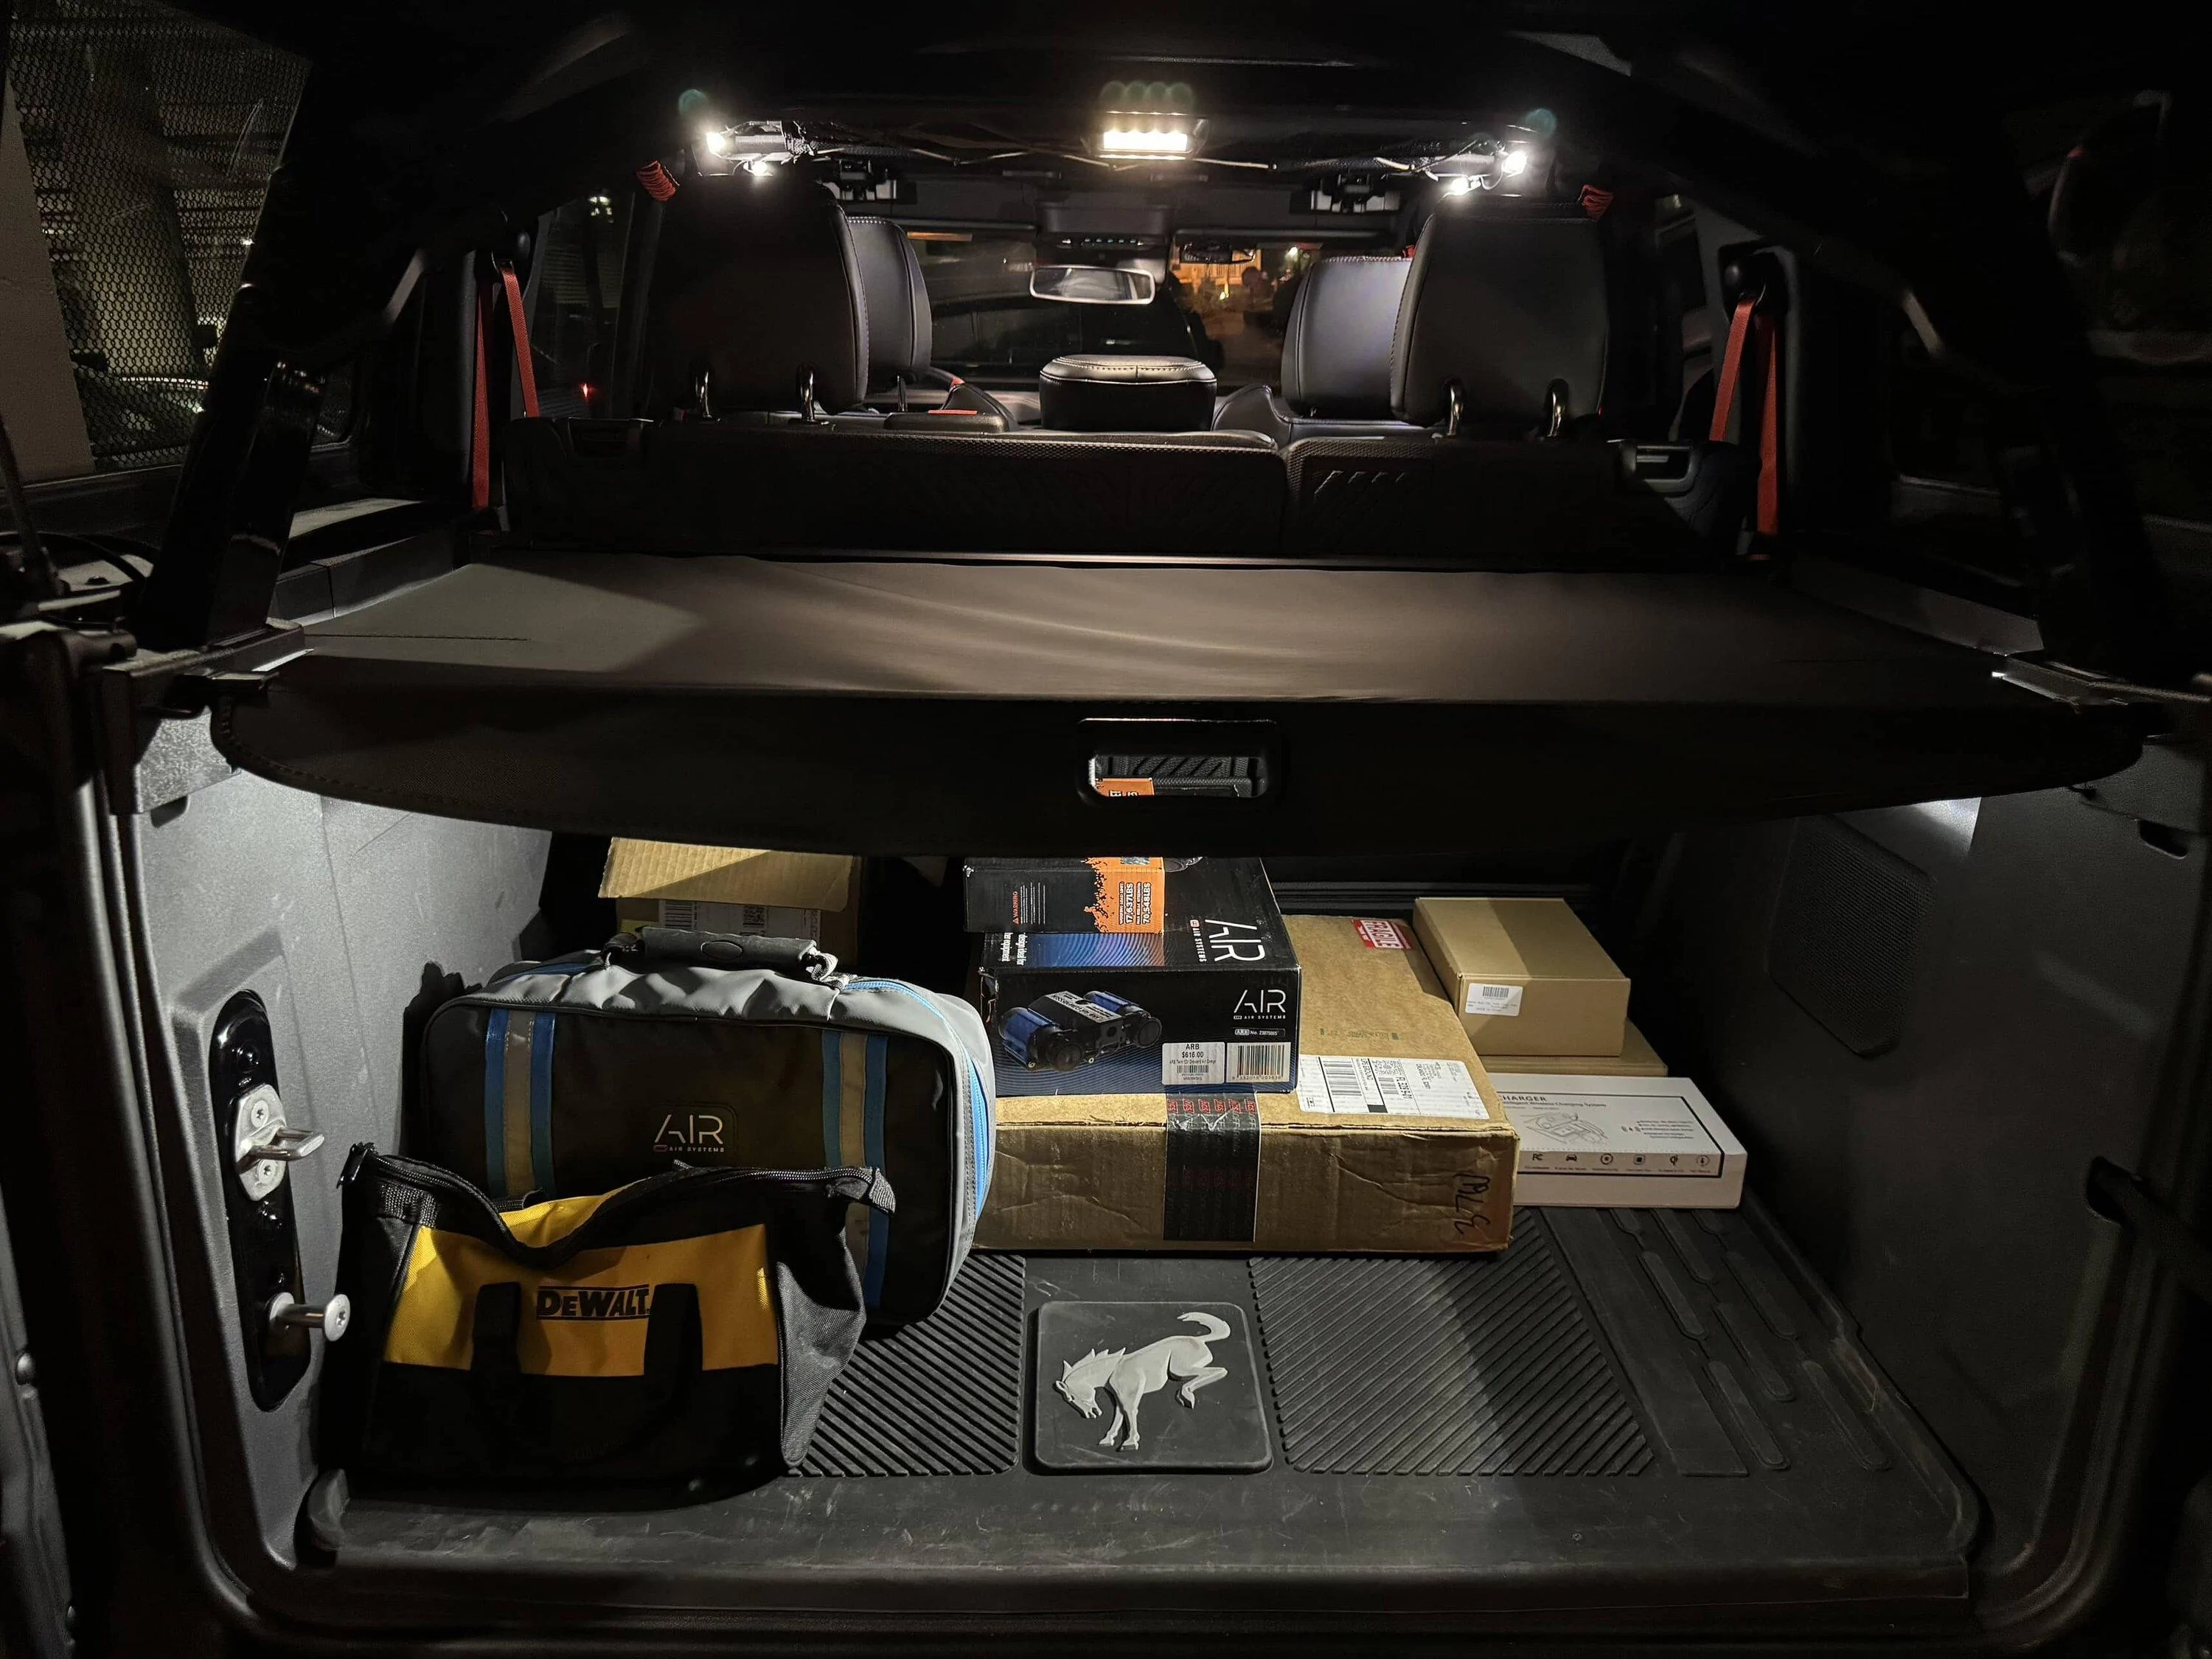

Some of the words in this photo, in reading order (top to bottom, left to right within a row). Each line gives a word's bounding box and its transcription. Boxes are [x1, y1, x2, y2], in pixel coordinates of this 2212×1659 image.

[1204, 919, 1266, 961] AIR
[1365, 921, 1399, 947] FRAGILE
[1194, 938, 1207, 962] SYSTEMS
[1234, 989, 1286, 1013] AIR
[654, 1114, 723, 1144] AIR
